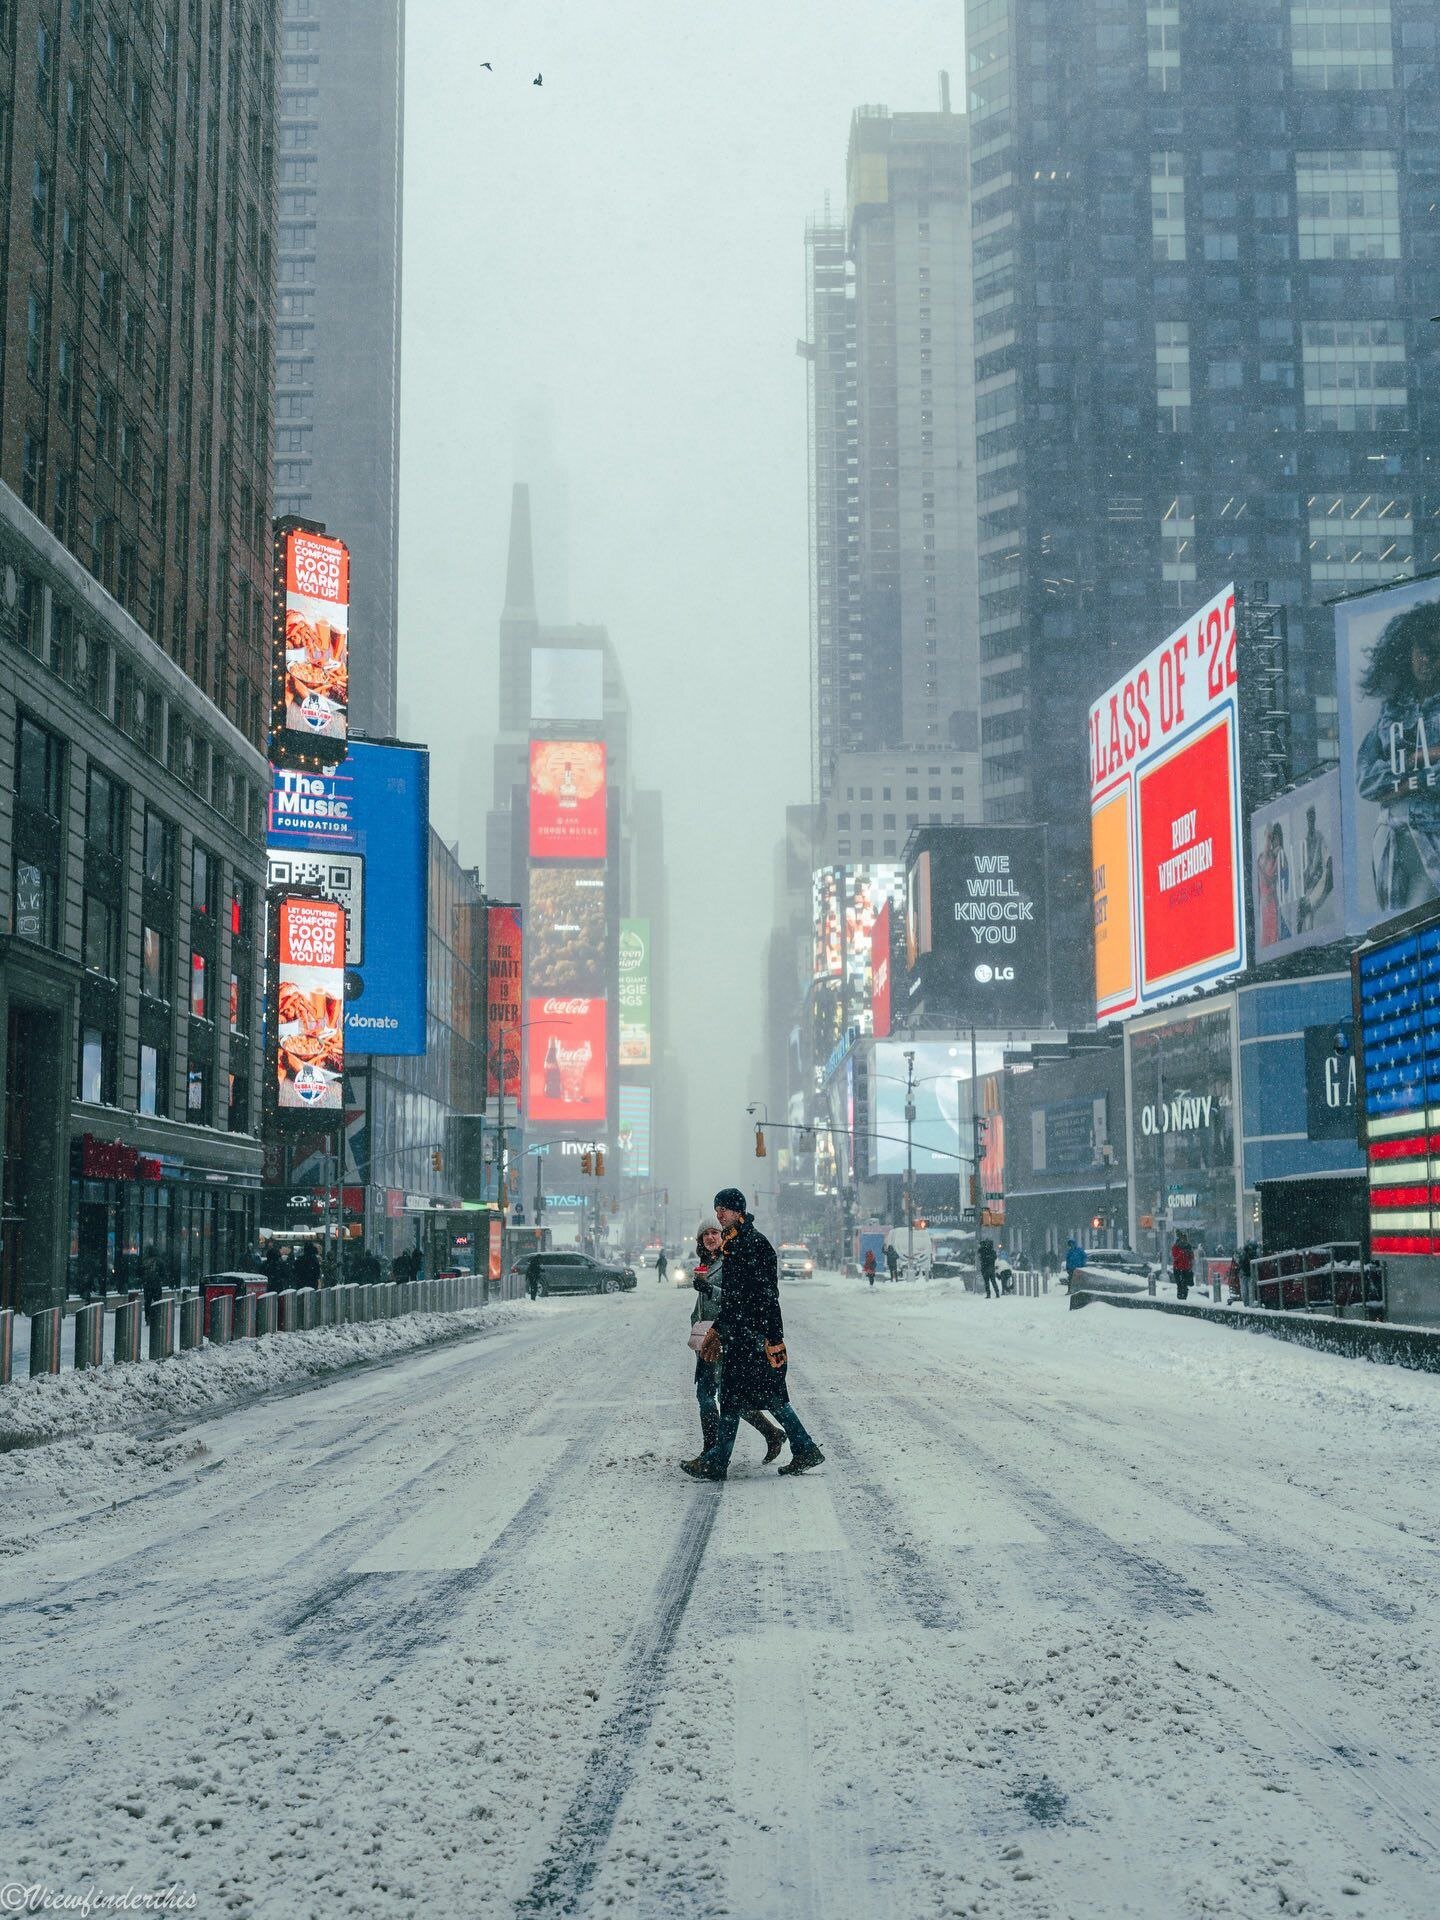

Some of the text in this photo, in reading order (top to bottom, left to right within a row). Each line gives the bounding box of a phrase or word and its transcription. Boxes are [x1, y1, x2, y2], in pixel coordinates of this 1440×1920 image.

[294, 545, 341, 566] COMFORT
[295, 555, 340, 578] FOOD
[295, 568, 339, 590] WARM
[296, 581, 338, 600] YOU UP!
[1158, 633, 1188, 735] OF
[279, 771, 325, 796] The
[278, 791, 348, 818] Music
[277, 818, 348, 832] FOUNDATION
[1171, 808, 1197, 851] RUBY
[974, 855, 1010, 874] WE
[1158, 837, 1213, 893] WHITEHORN
[966, 879, 1020, 897] WILL
[287, 914, 338, 928] COMFORT
[954, 902, 1034, 921] KNOCK
[289, 924, 336, 942] FOOD
[970, 926, 1017, 944] YOU
[288, 937, 335, 955] WARM
[497, 945, 513, 959] THE
[289, 950, 335, 964] YOU UP!
[489, 960, 520, 978] WAIT
[994, 966, 1016, 981] LG
[489, 1003, 519, 1022] OVER
[1325, 1055, 1357, 1108] GA
[1141, 1105, 1170, 1136] OLD
[1171, 1095, 1213, 1132] NAVY
[545, 1195, 589, 1207] STASH
[1168, 1193, 1198, 1208] OLD NAVY
